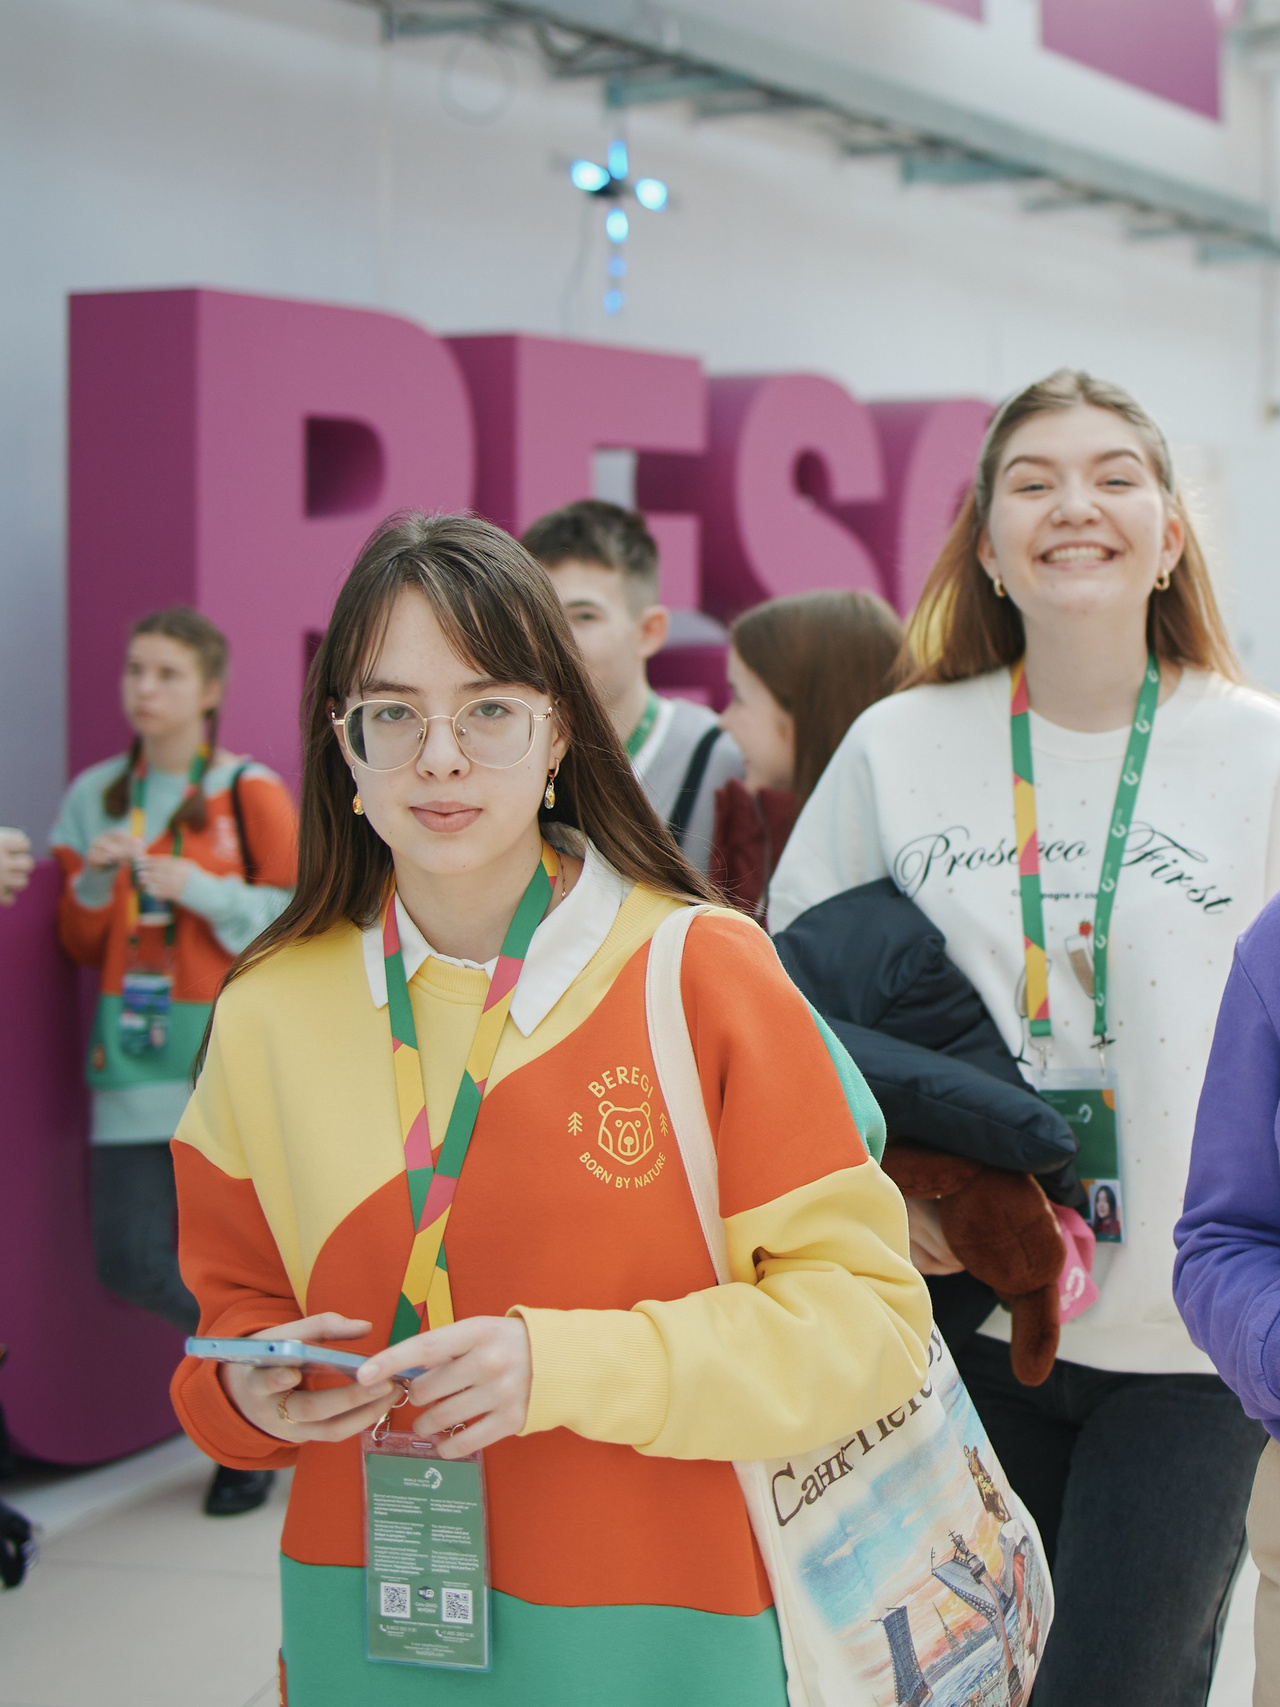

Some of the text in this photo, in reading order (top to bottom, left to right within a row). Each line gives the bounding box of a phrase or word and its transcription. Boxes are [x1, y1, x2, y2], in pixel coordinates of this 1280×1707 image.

[1121, 821, 1232, 915] First
[588, 1066, 654, 1099] BEREGI
[579, 1151, 667, 1189] BORN BY NATURE
